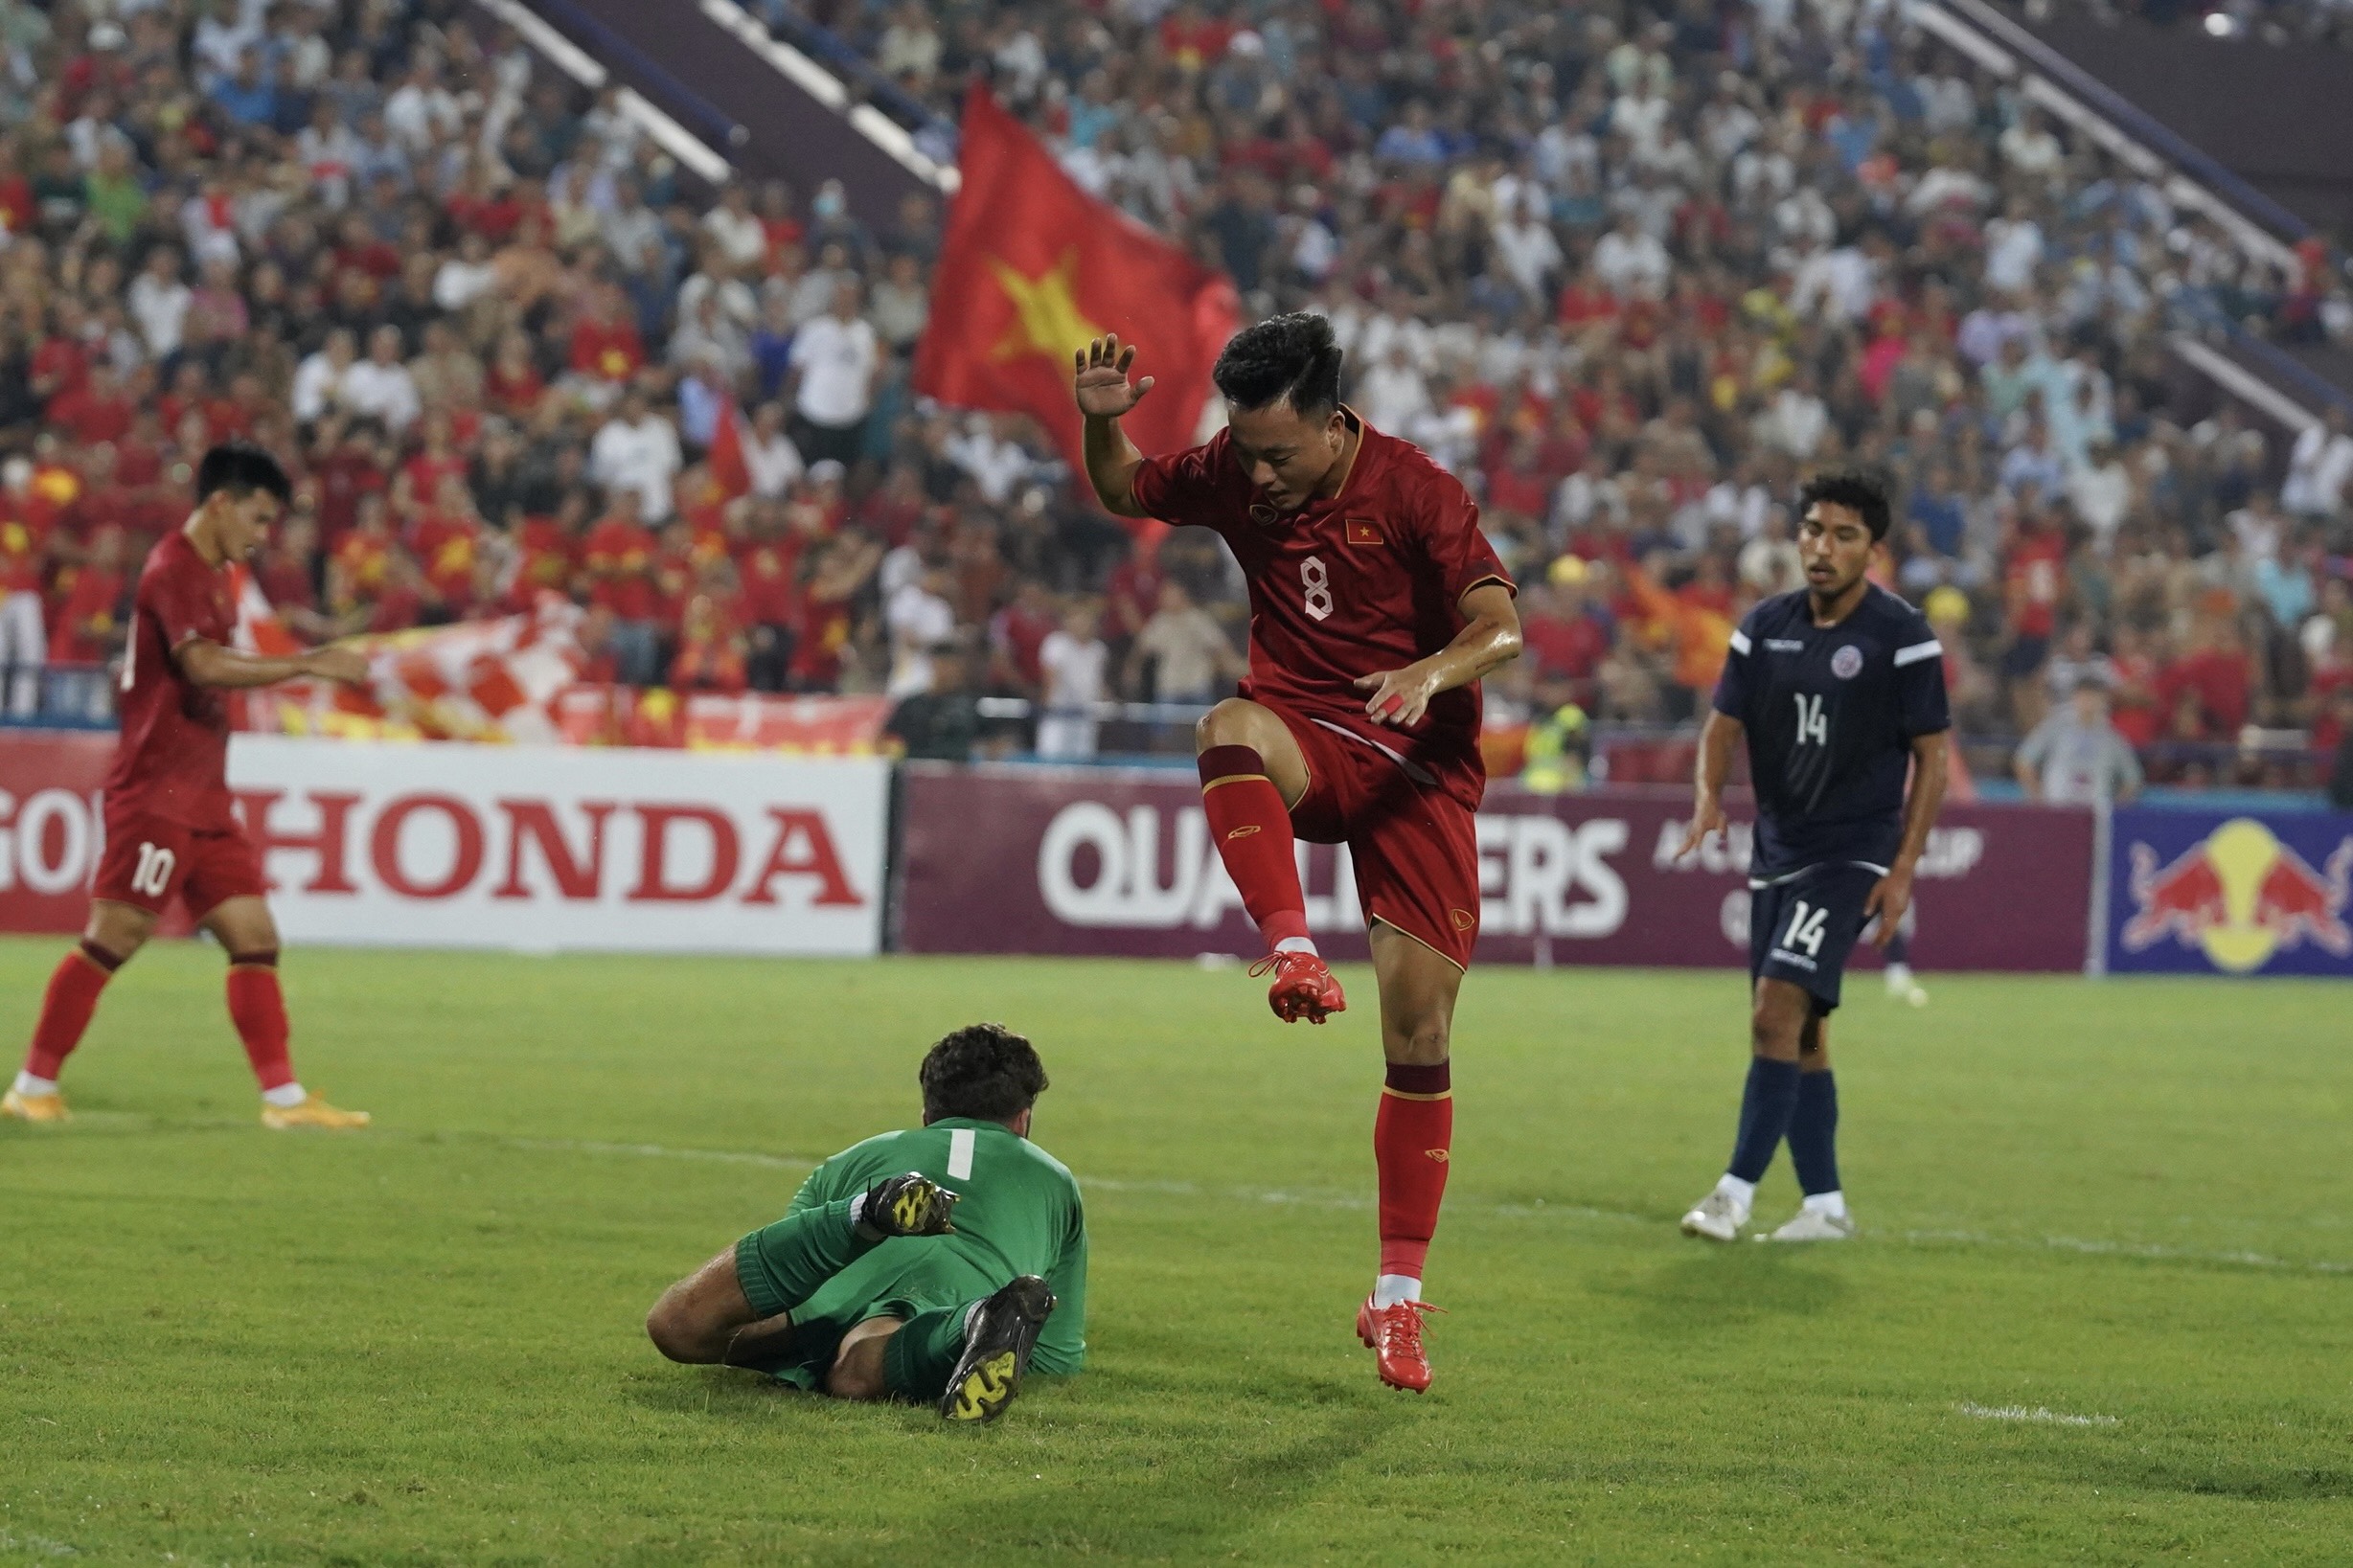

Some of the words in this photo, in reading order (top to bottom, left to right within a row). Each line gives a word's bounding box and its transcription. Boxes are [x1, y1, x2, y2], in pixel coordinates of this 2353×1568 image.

[1299, 556, 1334, 622] 8
[1793, 693, 1827, 746] 14
[131, 842, 176, 898] 10
[232, 786, 865, 907] HONDA
[1038, 800, 1629, 939] QULIERS
[1782, 900, 1829, 958] 14
